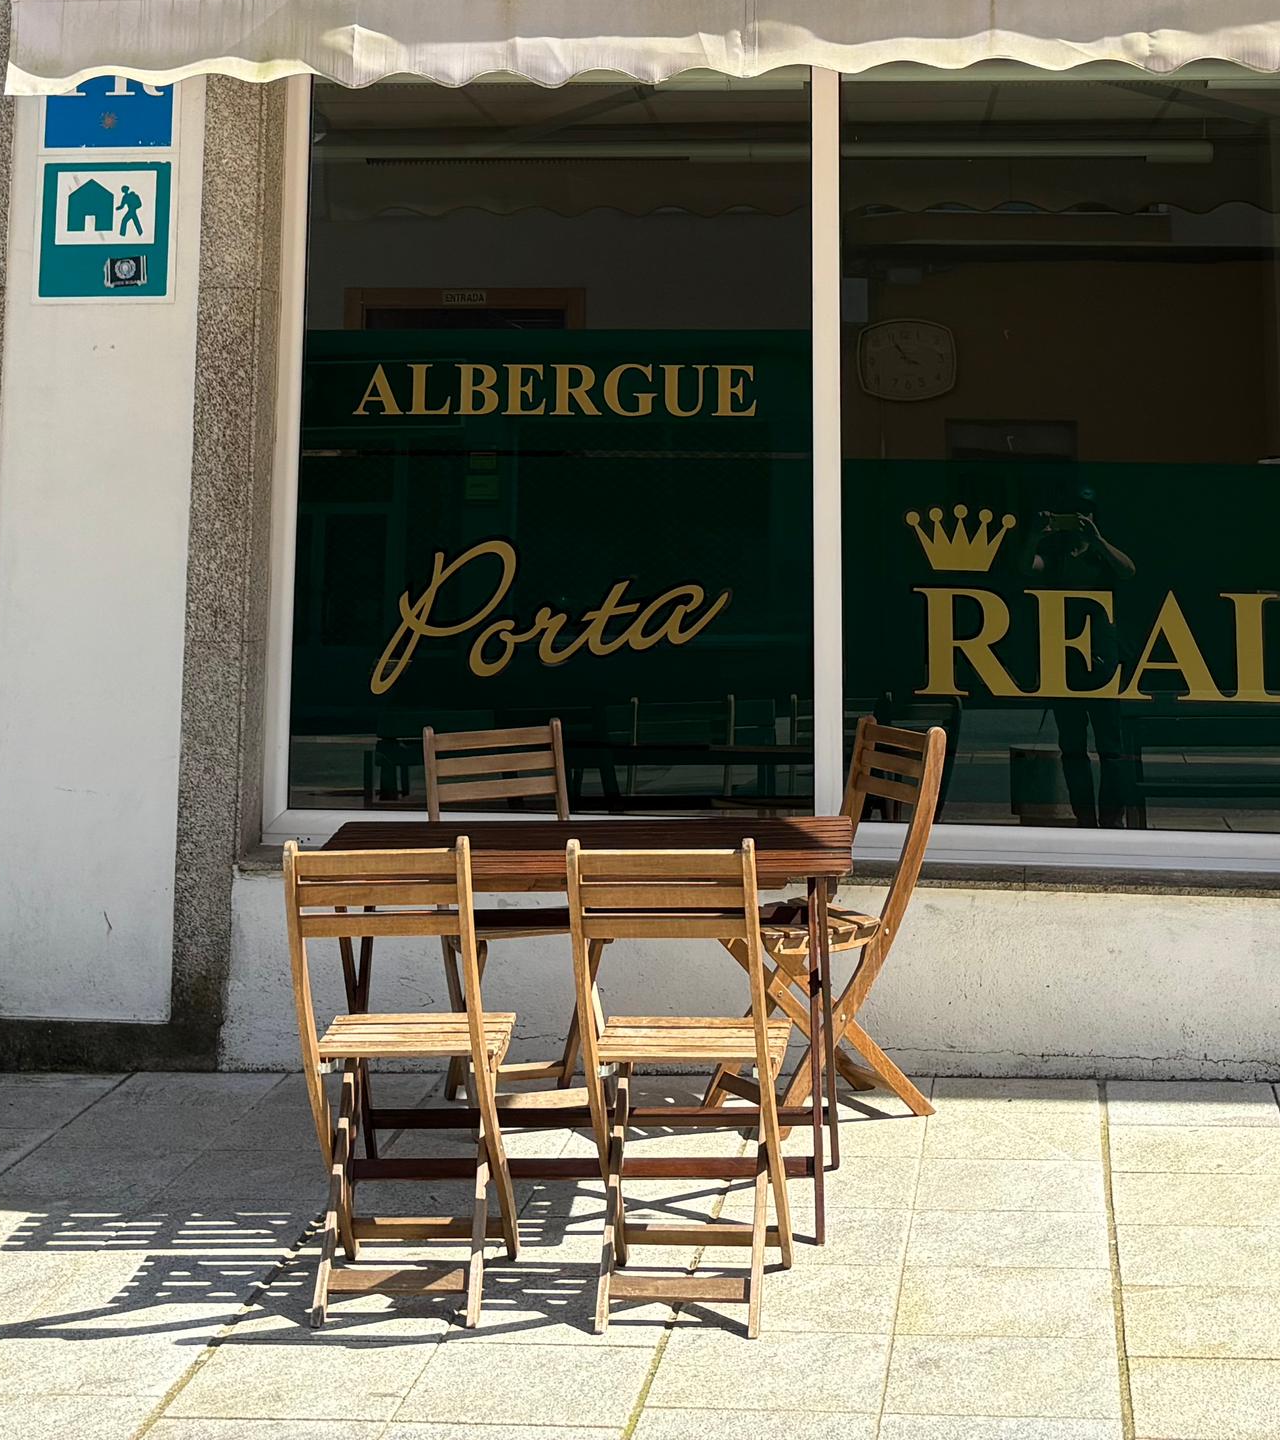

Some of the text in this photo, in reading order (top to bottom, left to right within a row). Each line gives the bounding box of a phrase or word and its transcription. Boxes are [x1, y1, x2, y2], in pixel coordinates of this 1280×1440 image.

[445, 293, 485, 303] ENTRADA
[353, 363, 757, 417] ALBERGUE
[370, 540, 729, 695] Porta
